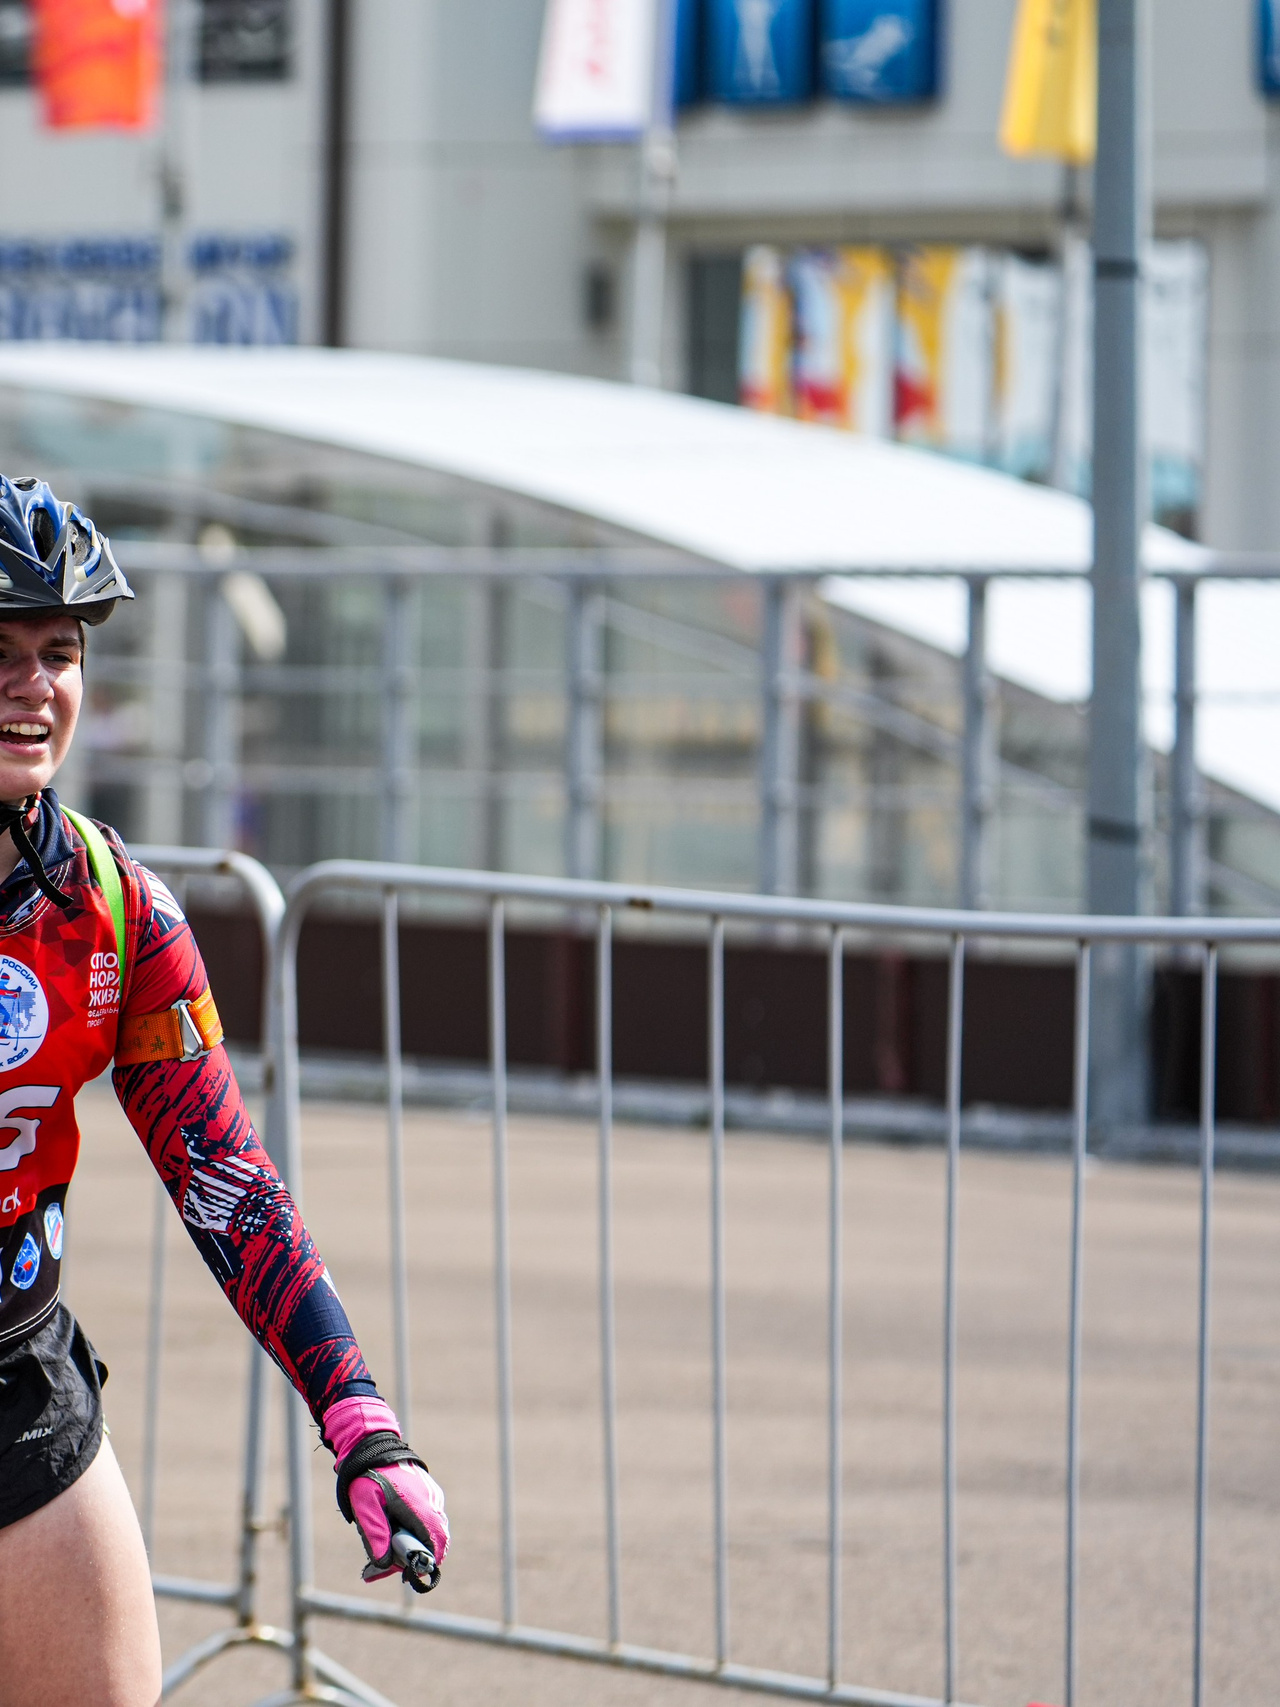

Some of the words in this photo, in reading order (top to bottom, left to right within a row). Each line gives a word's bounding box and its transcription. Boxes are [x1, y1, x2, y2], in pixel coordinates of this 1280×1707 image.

[1, 958, 38, 990] РОССИИ
[86, 1017, 105, 1028] ПРОЕКТ
[7, 1047, 29, 1065] 2023
